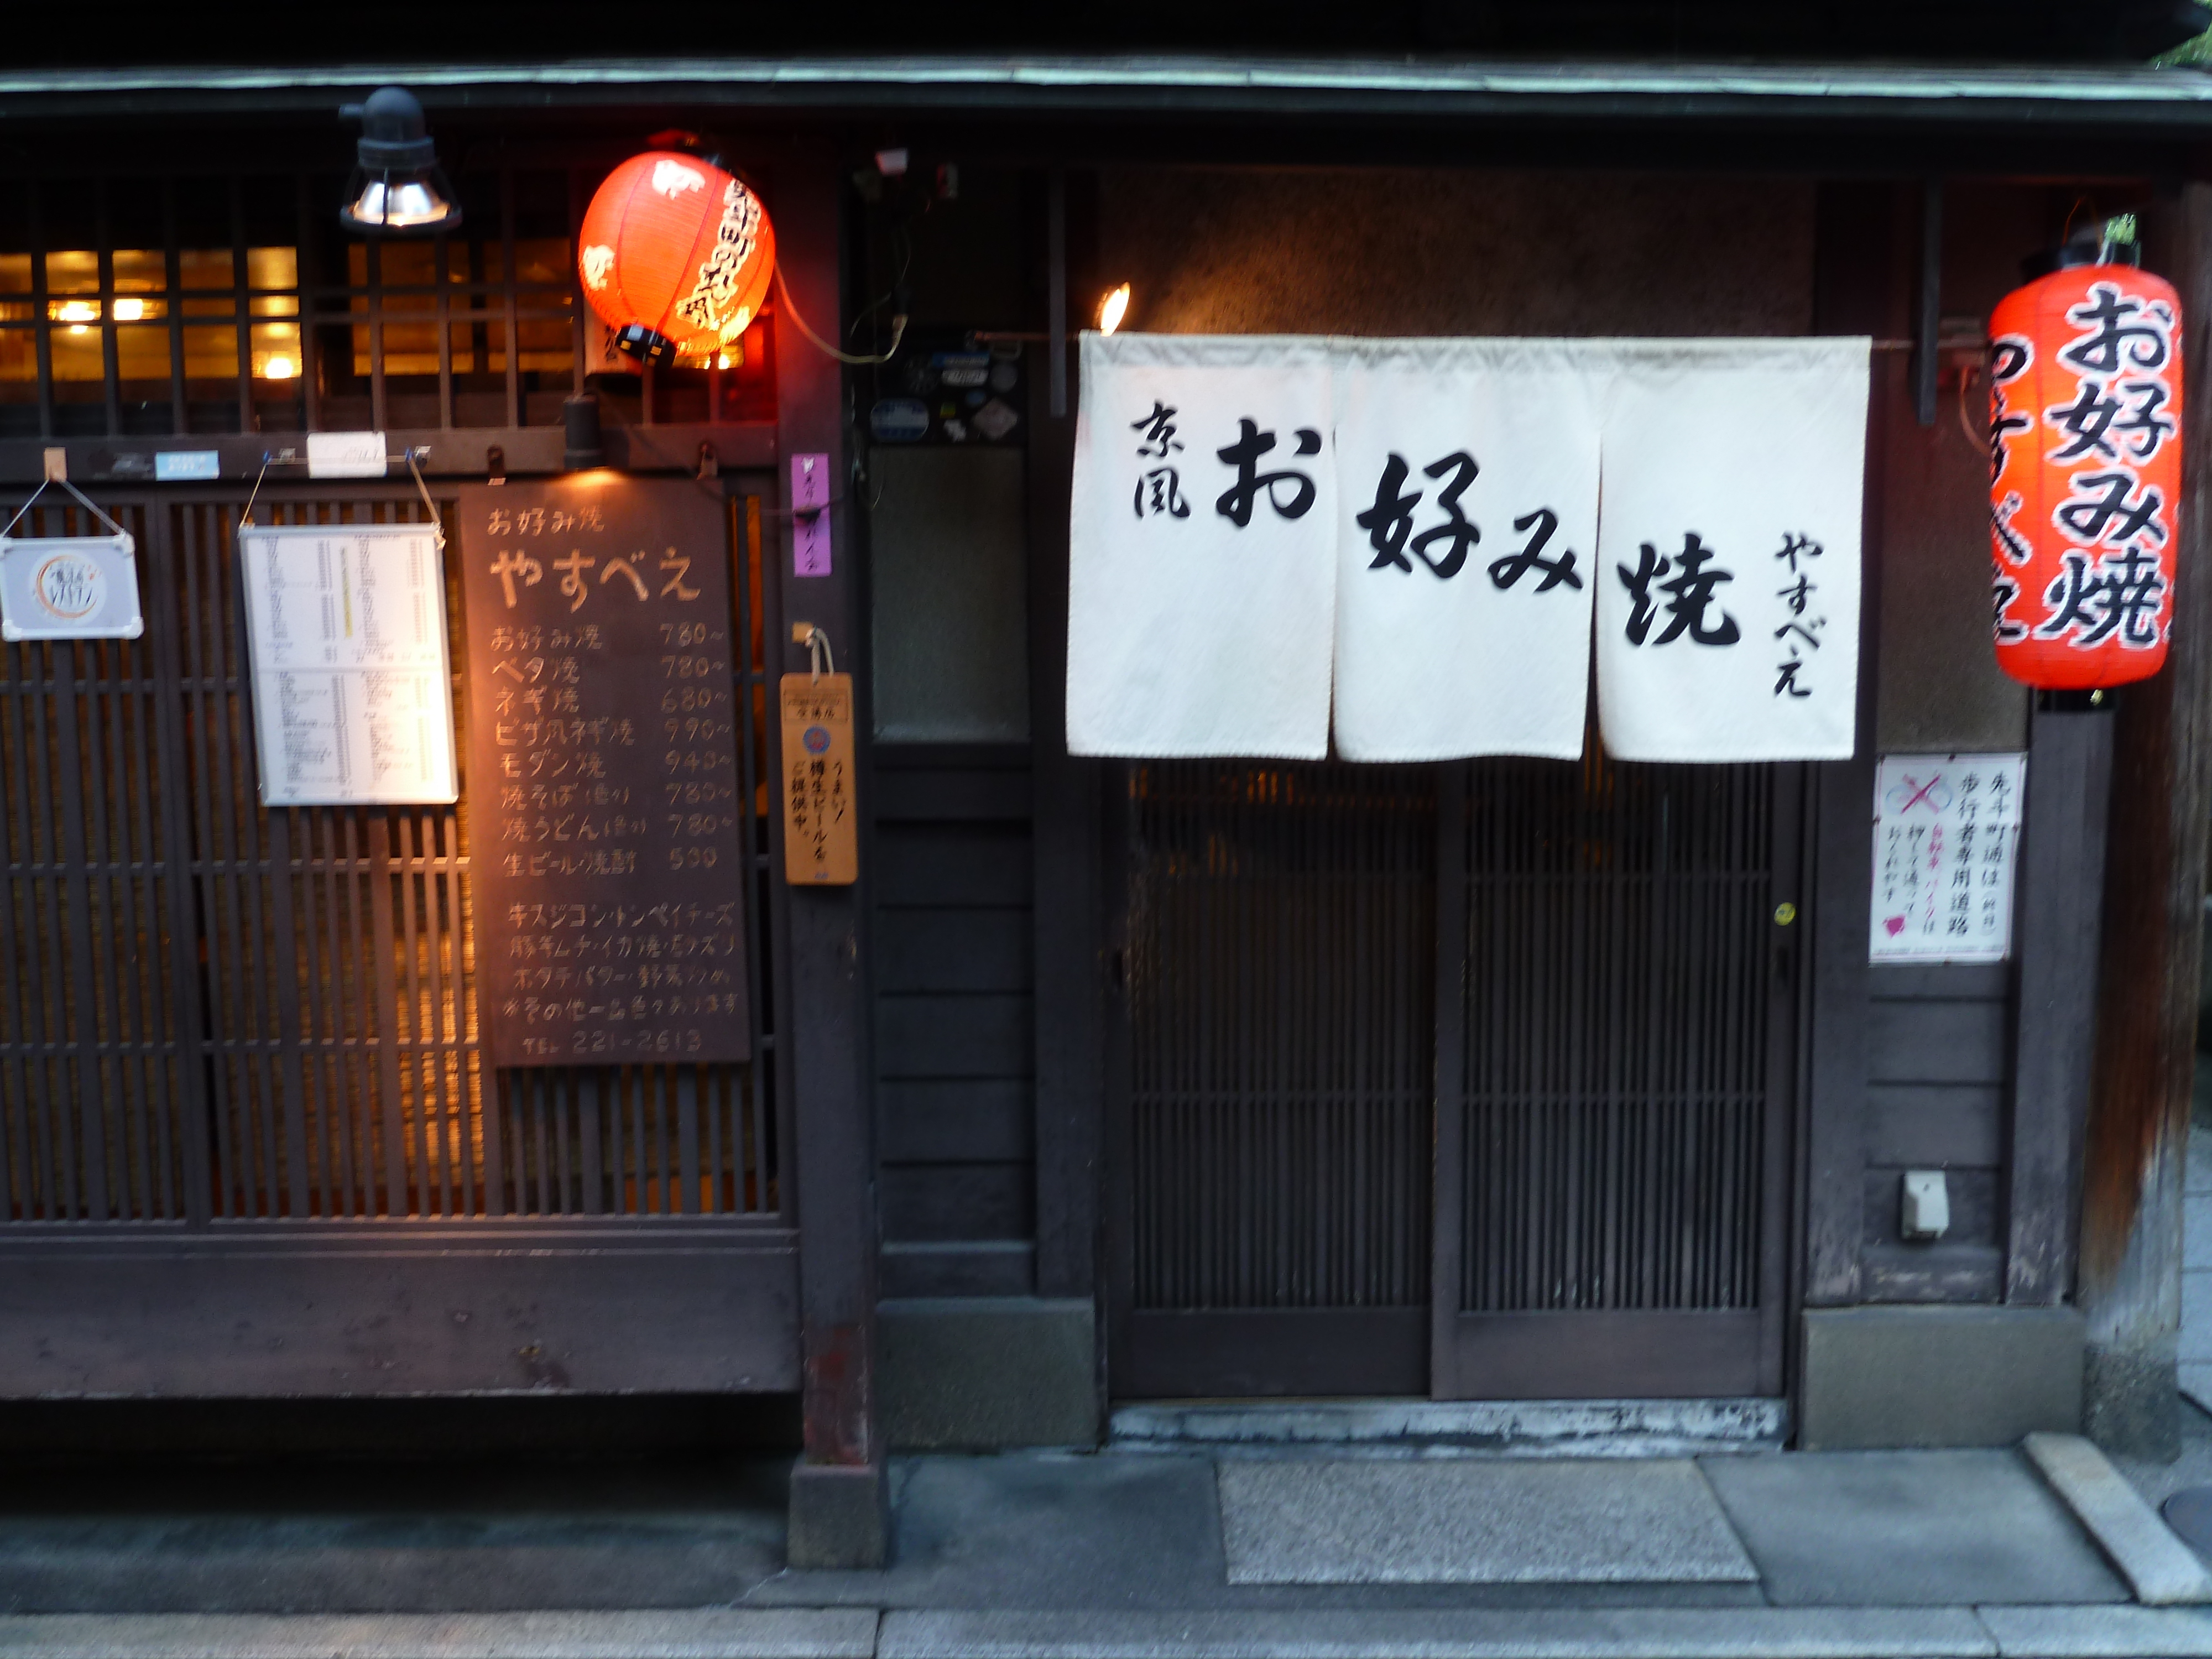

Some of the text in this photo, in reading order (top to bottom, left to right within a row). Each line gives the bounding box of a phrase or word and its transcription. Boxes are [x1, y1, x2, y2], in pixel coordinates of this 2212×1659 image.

[1131, 399, 1191, 519] 京風
[2035, 284, 2176, 648] お好み焼
[487, 505, 605, 535] お好み焼
[1215, 416, 1740, 647] お好み焼
[490, 546, 701, 613] やすべえ
[1773, 531, 1827, 698] やすべえ
[491, 624, 602, 651] お好み焼
[500, 749, 606, 778] モダン焼
[1947, 771, 1980, 937] 歩行者専用道路
[572, 1029, 702, 1052] 221-2613
